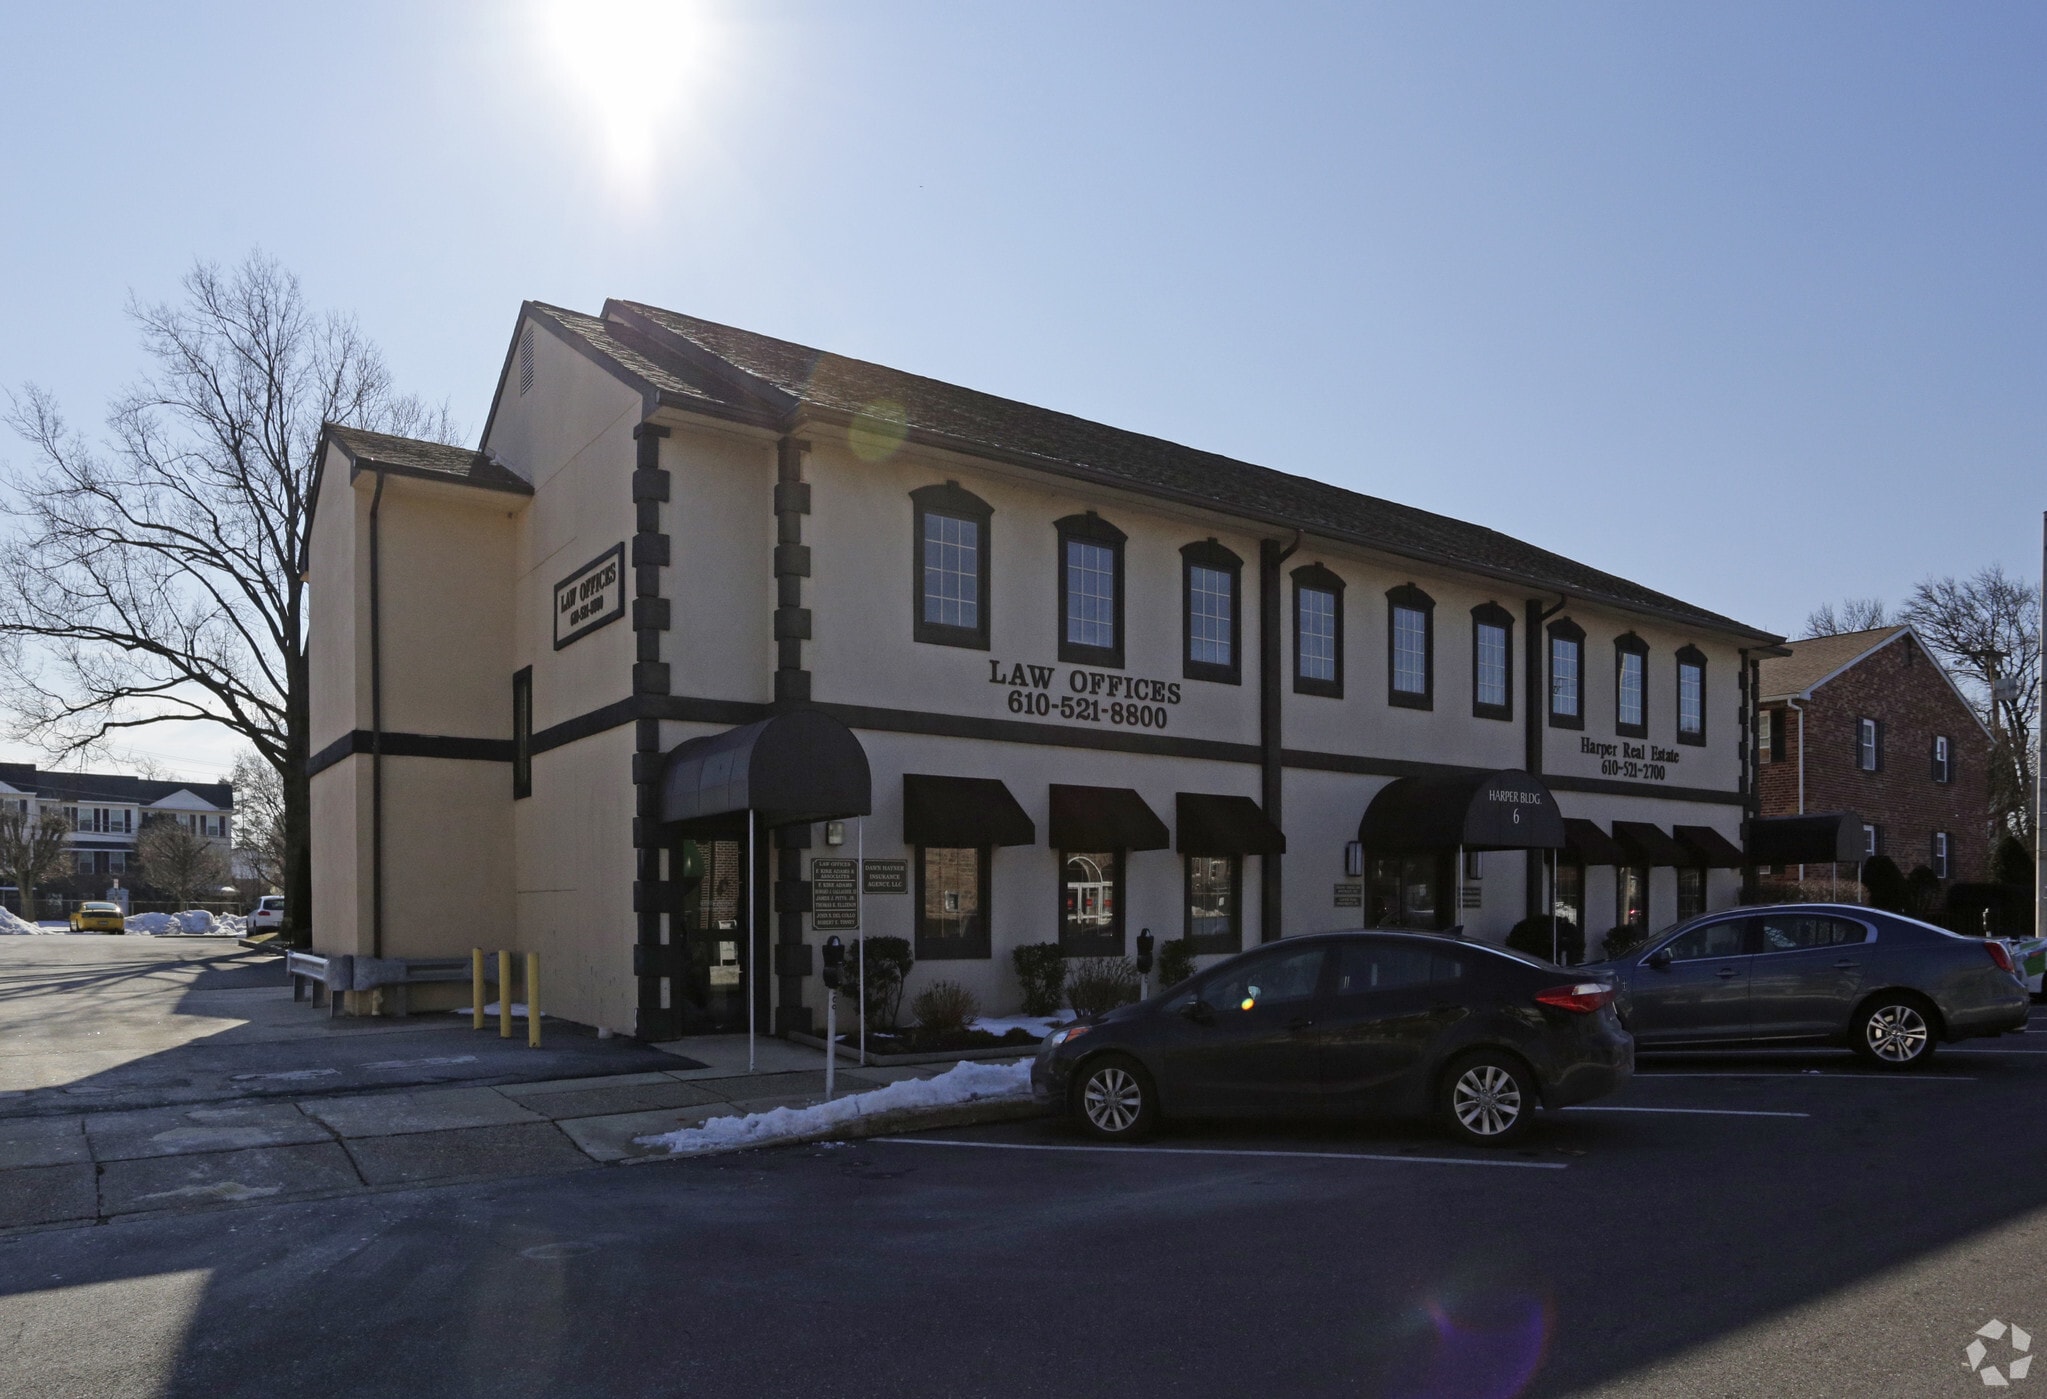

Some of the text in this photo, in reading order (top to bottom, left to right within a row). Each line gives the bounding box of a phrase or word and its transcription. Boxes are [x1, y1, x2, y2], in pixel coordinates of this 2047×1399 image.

[561, 562, 616, 613] LAW OFFICES
[989, 660, 1182, 705] LAW OFFICES
[1007, 690, 1168, 729] 610-521-8800
[1581, 736, 1679, 764] Harper Real Estate
[1601, 760, 1665, 780] 610-521-2700
[1489, 789, 1542, 805] HARPER BLDG.
[1513, 808, 1520, 824] 6
